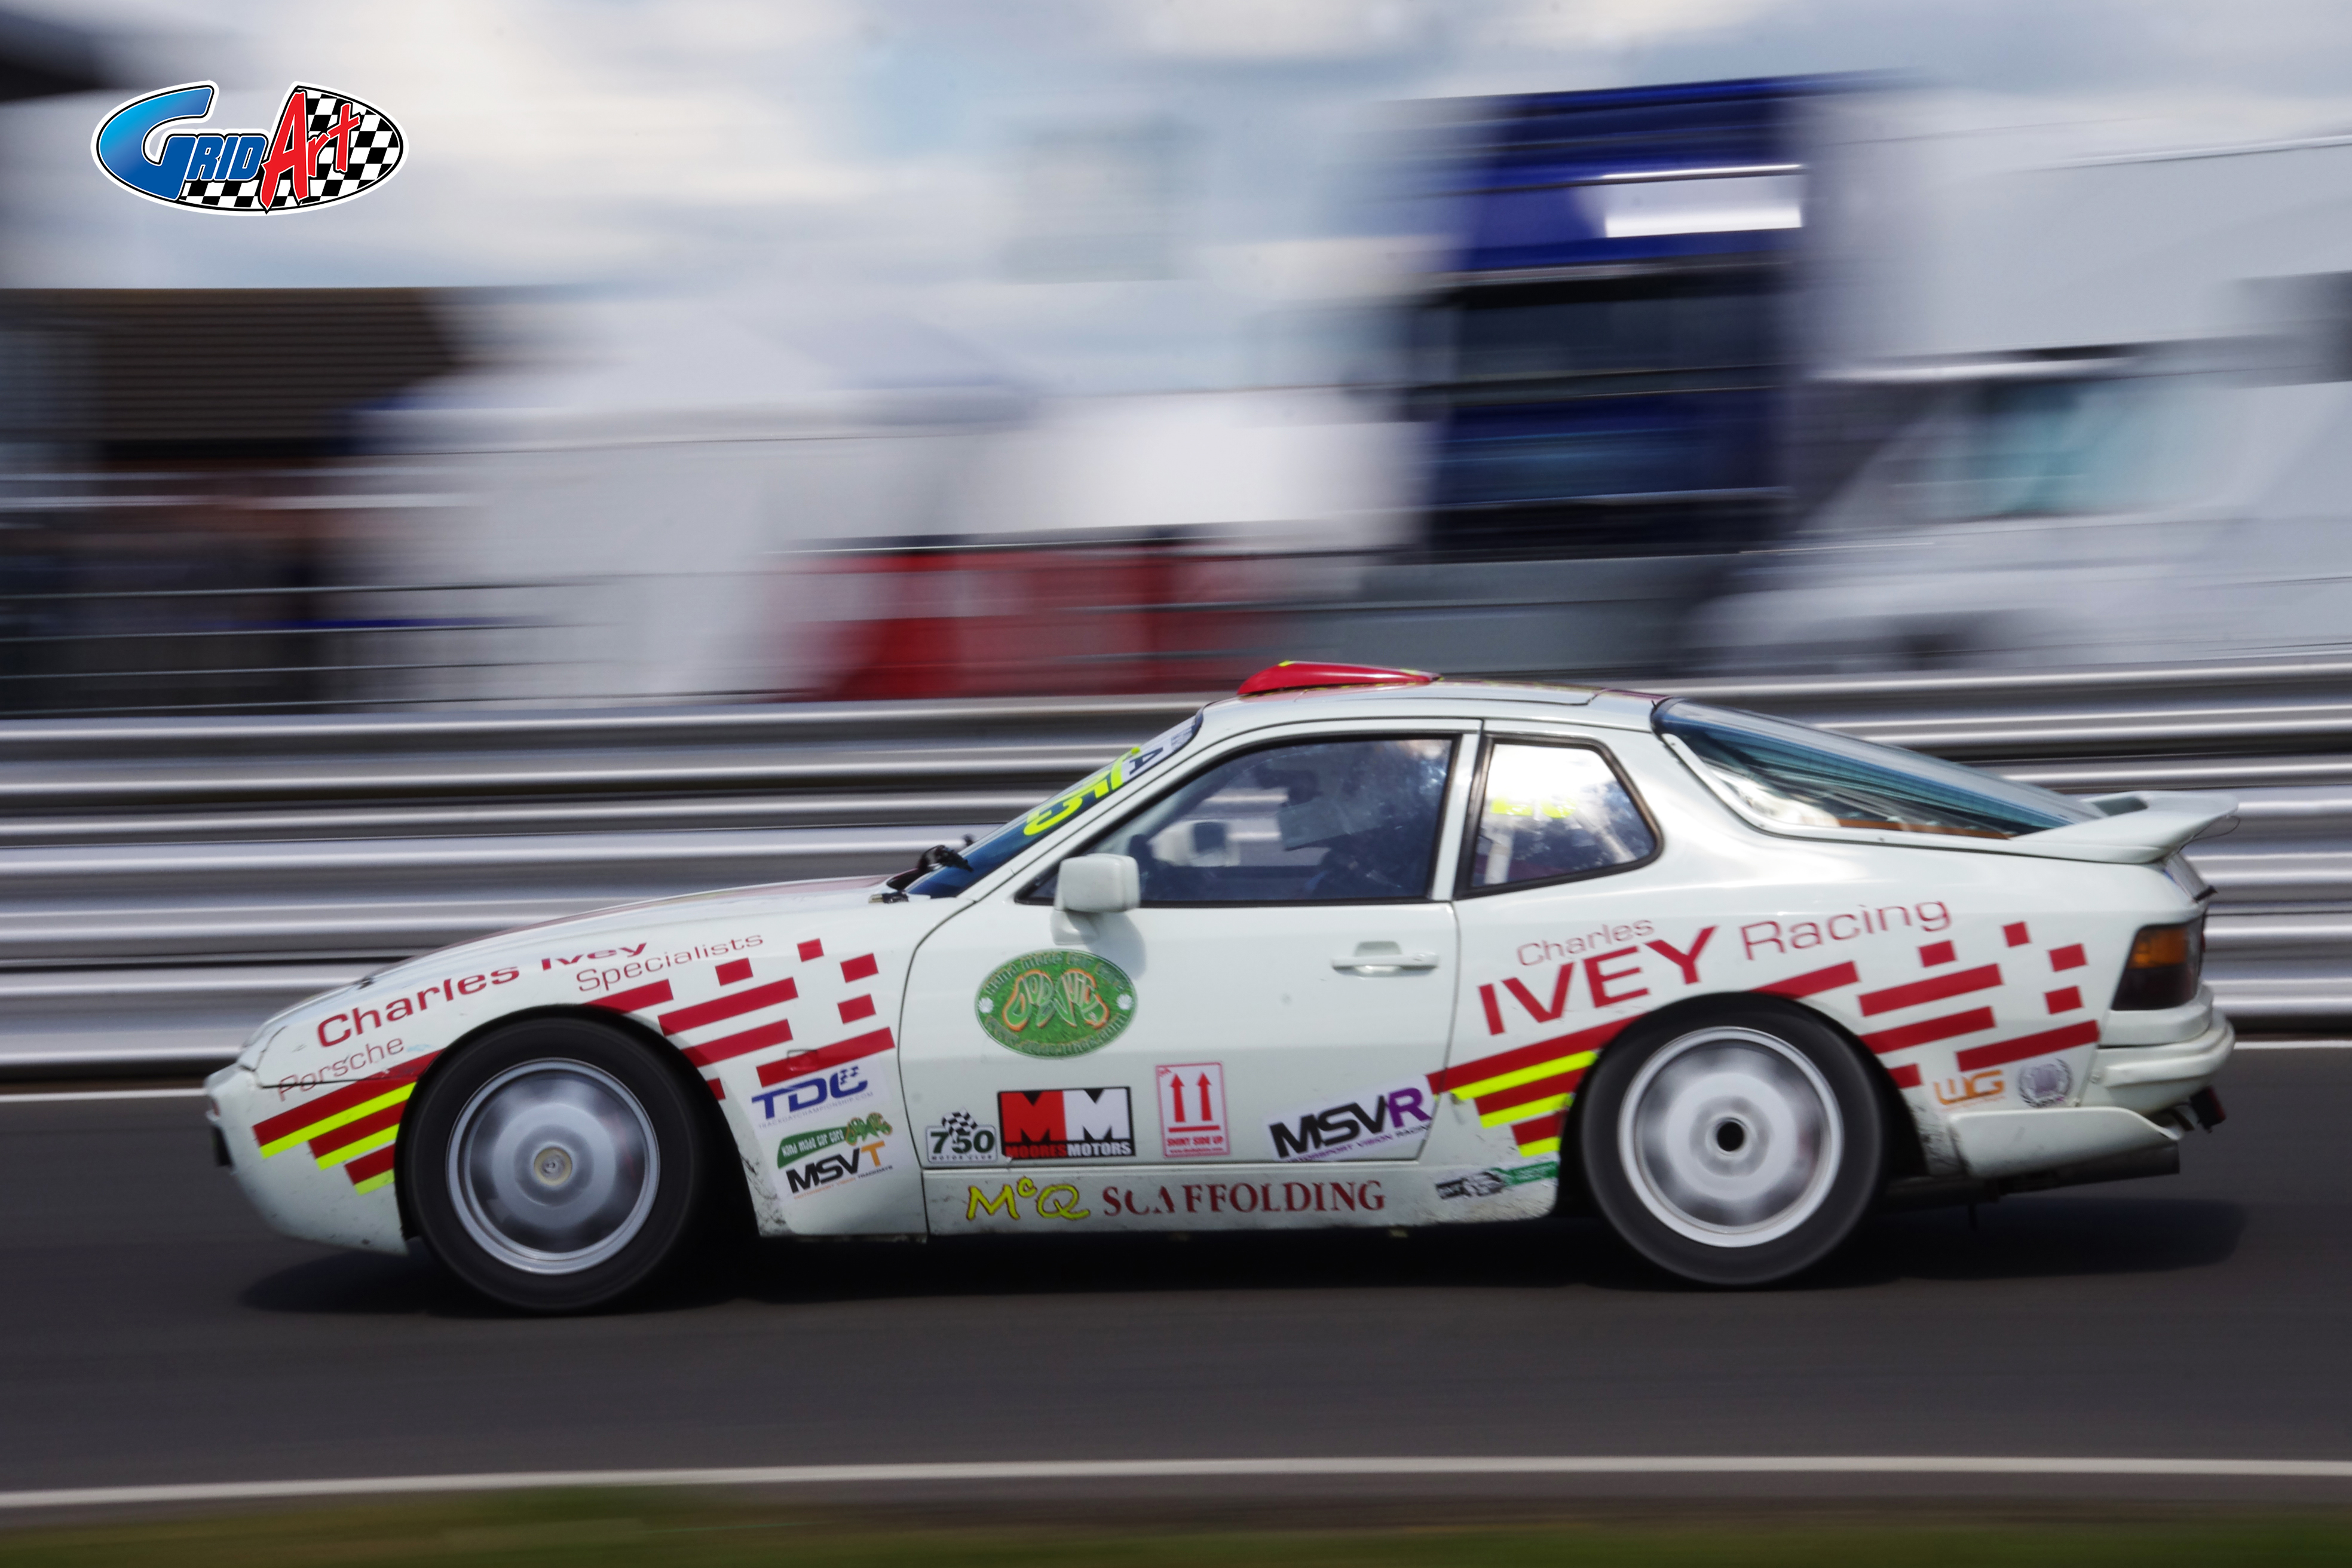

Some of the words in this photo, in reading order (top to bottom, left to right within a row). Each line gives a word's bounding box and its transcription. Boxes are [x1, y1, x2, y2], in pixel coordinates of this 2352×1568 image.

[576, 934, 764, 992] Specialists
[1478, 924, 1719, 1036] IVEY
[1740, 900, 1952, 960] Racing
[1517, 917, 1655, 967] Charles
[317, 966, 520, 1049] Charles
[541, 942, 648, 972] Ivey
[278, 1037, 405, 1102] Porsche
[751, 1066, 869, 1119] TDC
[930, 1130, 995, 1154] 750
[1005, 1143, 1067, 1159] MOORES
[1067, 1141, 1131, 1157] MOTORS
[1269, 1087, 1433, 1159] MSVR
[785, 1140, 887, 1195] MSVT
[1103, 1180, 1386, 1217] SCAFFOLDING
